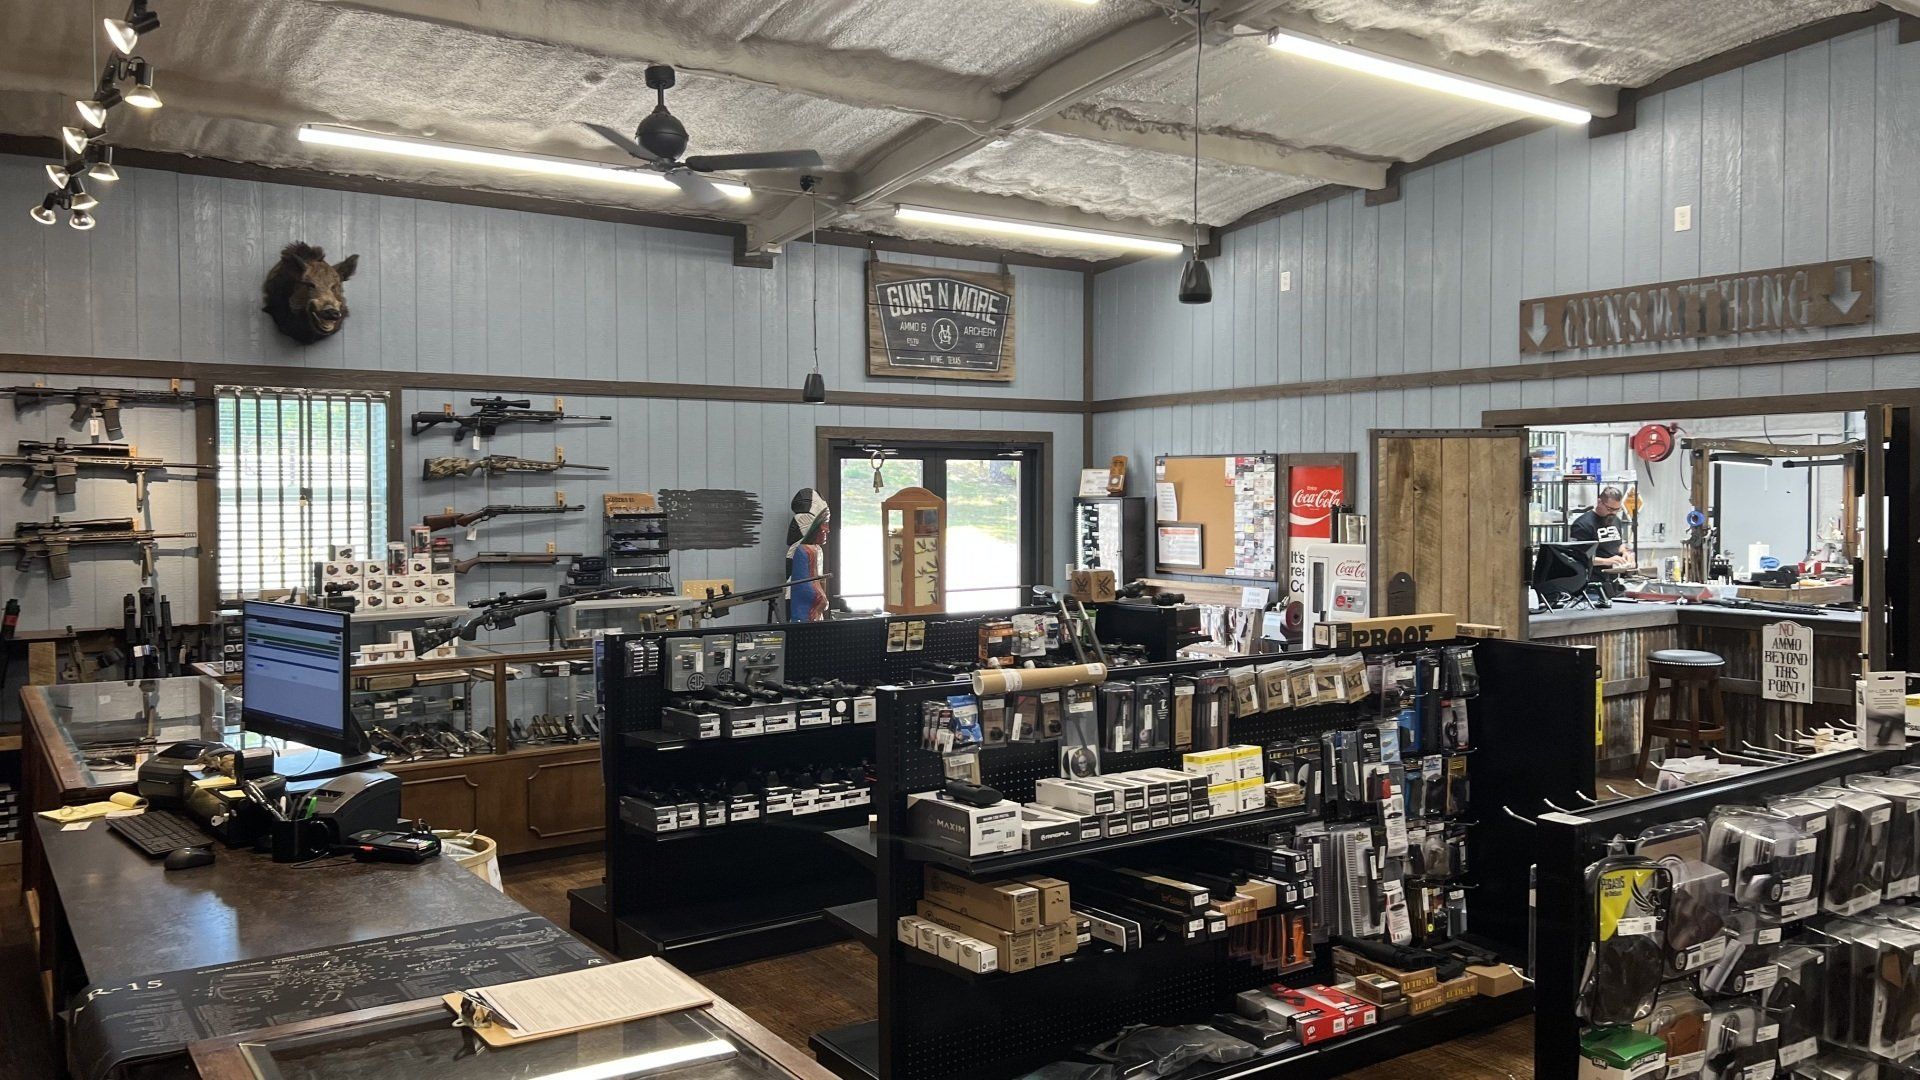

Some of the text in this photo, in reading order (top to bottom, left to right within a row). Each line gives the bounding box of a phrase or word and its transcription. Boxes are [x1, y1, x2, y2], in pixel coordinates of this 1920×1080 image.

[886, 282, 1000, 325] GUNS N MORE
[1561, 270, 1810, 348] GUNSMITHING
[900, 321, 920, 332] AMMO
[964, 326, 997, 337] ARCHERY
[1291, 551, 1305, 564] It's
[1353, 624, 1434, 648] PROOF
[1779, 623, 1795, 637] NO
[1772, 637, 1802, 651] AMMO
[1764, 650, 1808, 666] BEYOND
[1774, 665, 1799, 680] THIS
[936, 818, 966, 834] MAXIM
